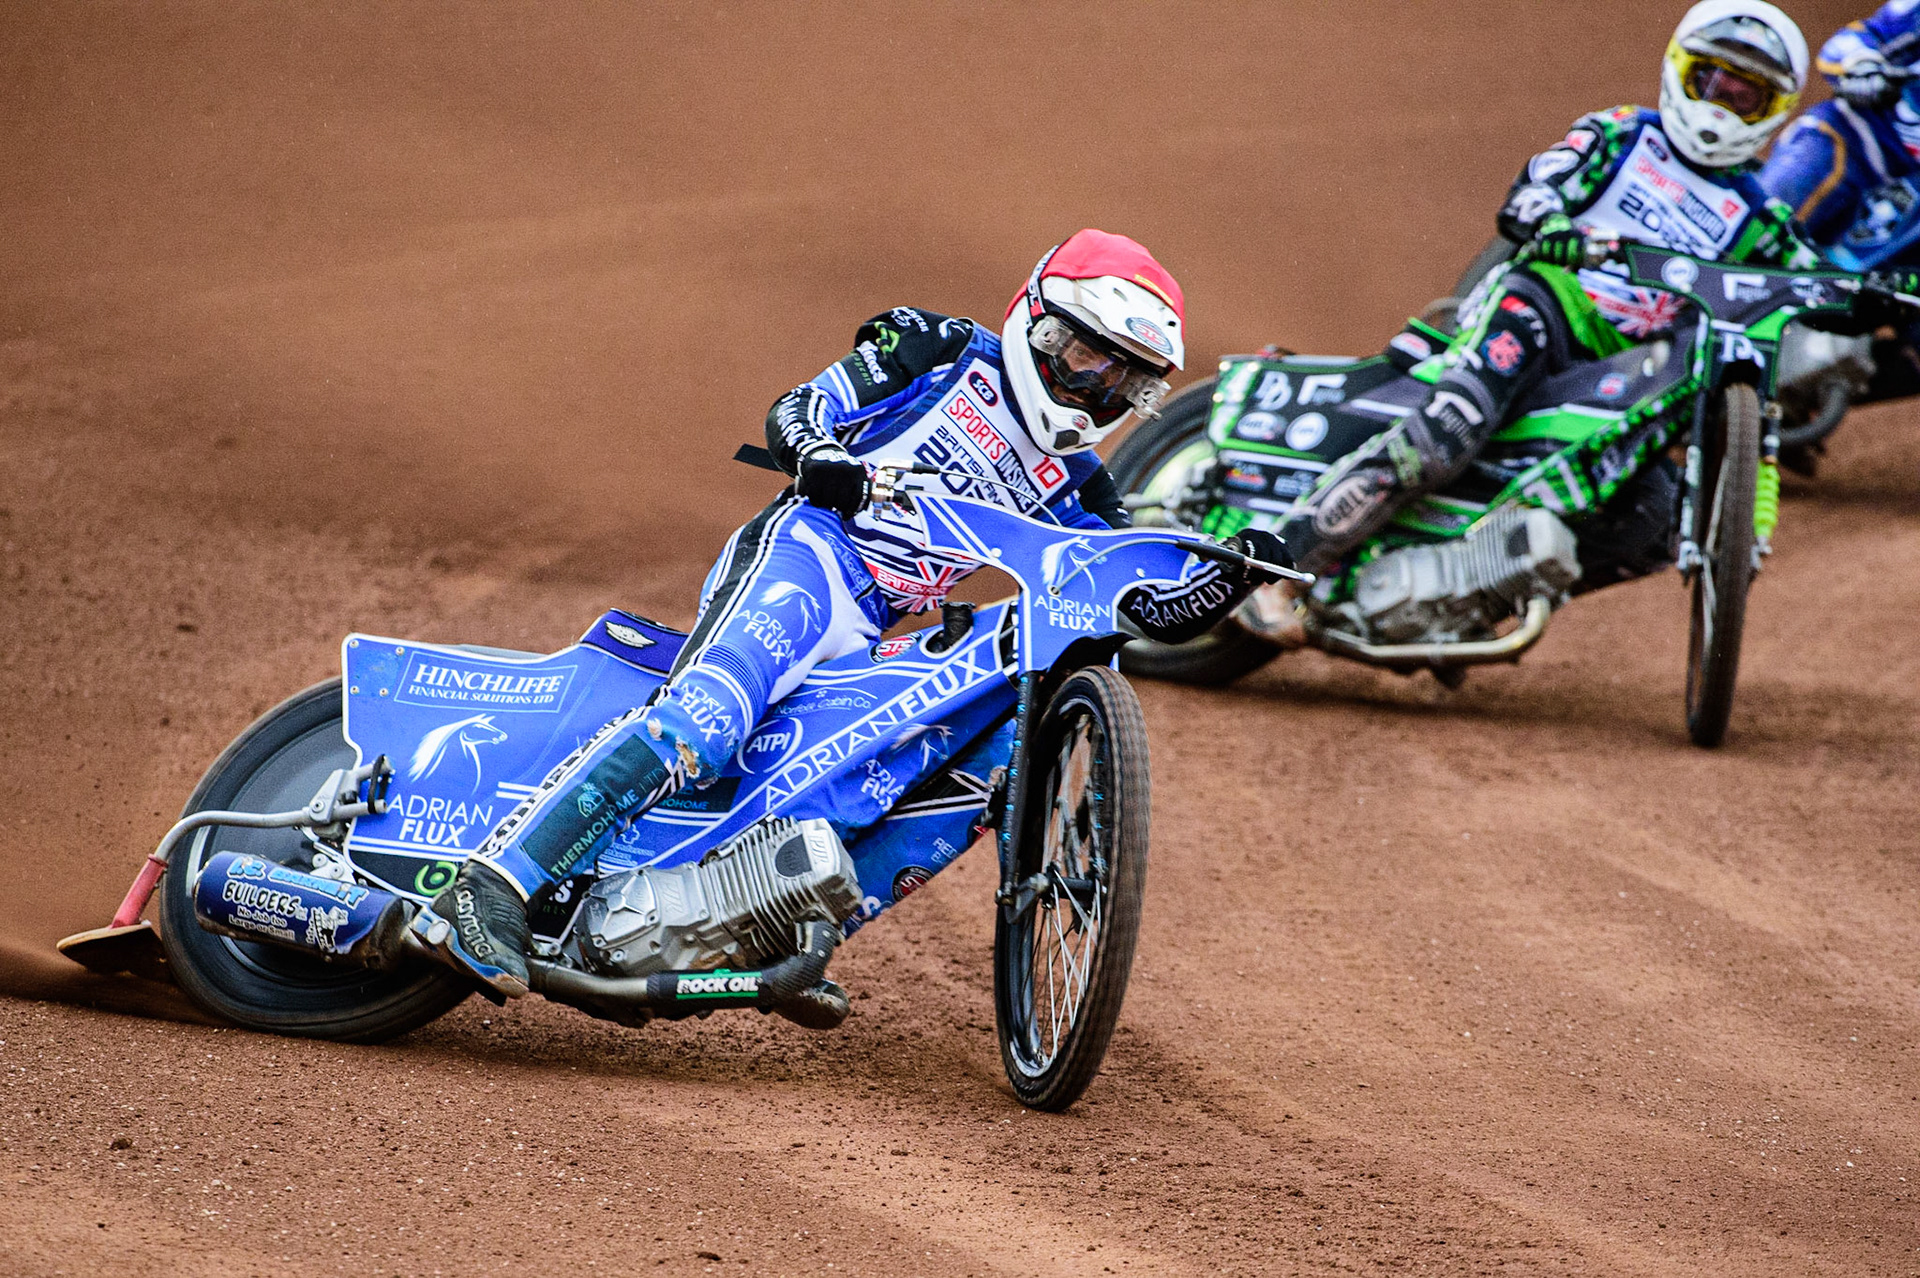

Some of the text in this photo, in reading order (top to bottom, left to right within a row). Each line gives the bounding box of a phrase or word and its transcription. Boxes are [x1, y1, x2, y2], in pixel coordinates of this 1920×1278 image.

[972, 379, 994, 401] SCB
[935, 425, 989, 482] BRITISH
[949, 397, 1039, 513] SPORTS INSURE
[1032, 455, 1065, 490] 10
[1033, 594, 1111, 618] ADRIAN
[1049, 611, 1097, 632] FLUX
[735, 610, 798, 670] ADRIAN
[743, 621, 789, 666] FLUX
[408, 684, 555, 705] FINANCIAL SOLUTIONS LTD
[413, 663, 565, 695] HINCHLIFFE
[679, 682, 742, 751] ADRIAN
[680, 691, 722, 743] FLUX
[764, 649, 991, 811] ADRIANFLUX
[747, 731, 791, 753] ATPI
[386, 794, 494, 827] ADRIAN
[399, 818, 468, 848] FLUX
[551, 787, 640, 881] THERMOHOME
[222, 879, 302, 918] BUILDERS
[228, 913, 257, 931] Large
[267, 923, 297, 940] Small
[237, 905, 252, 919] No
[252, 909, 271, 924] Job
[270, 913, 288, 927] too
[676, 976, 760, 994] ROCK OIL
